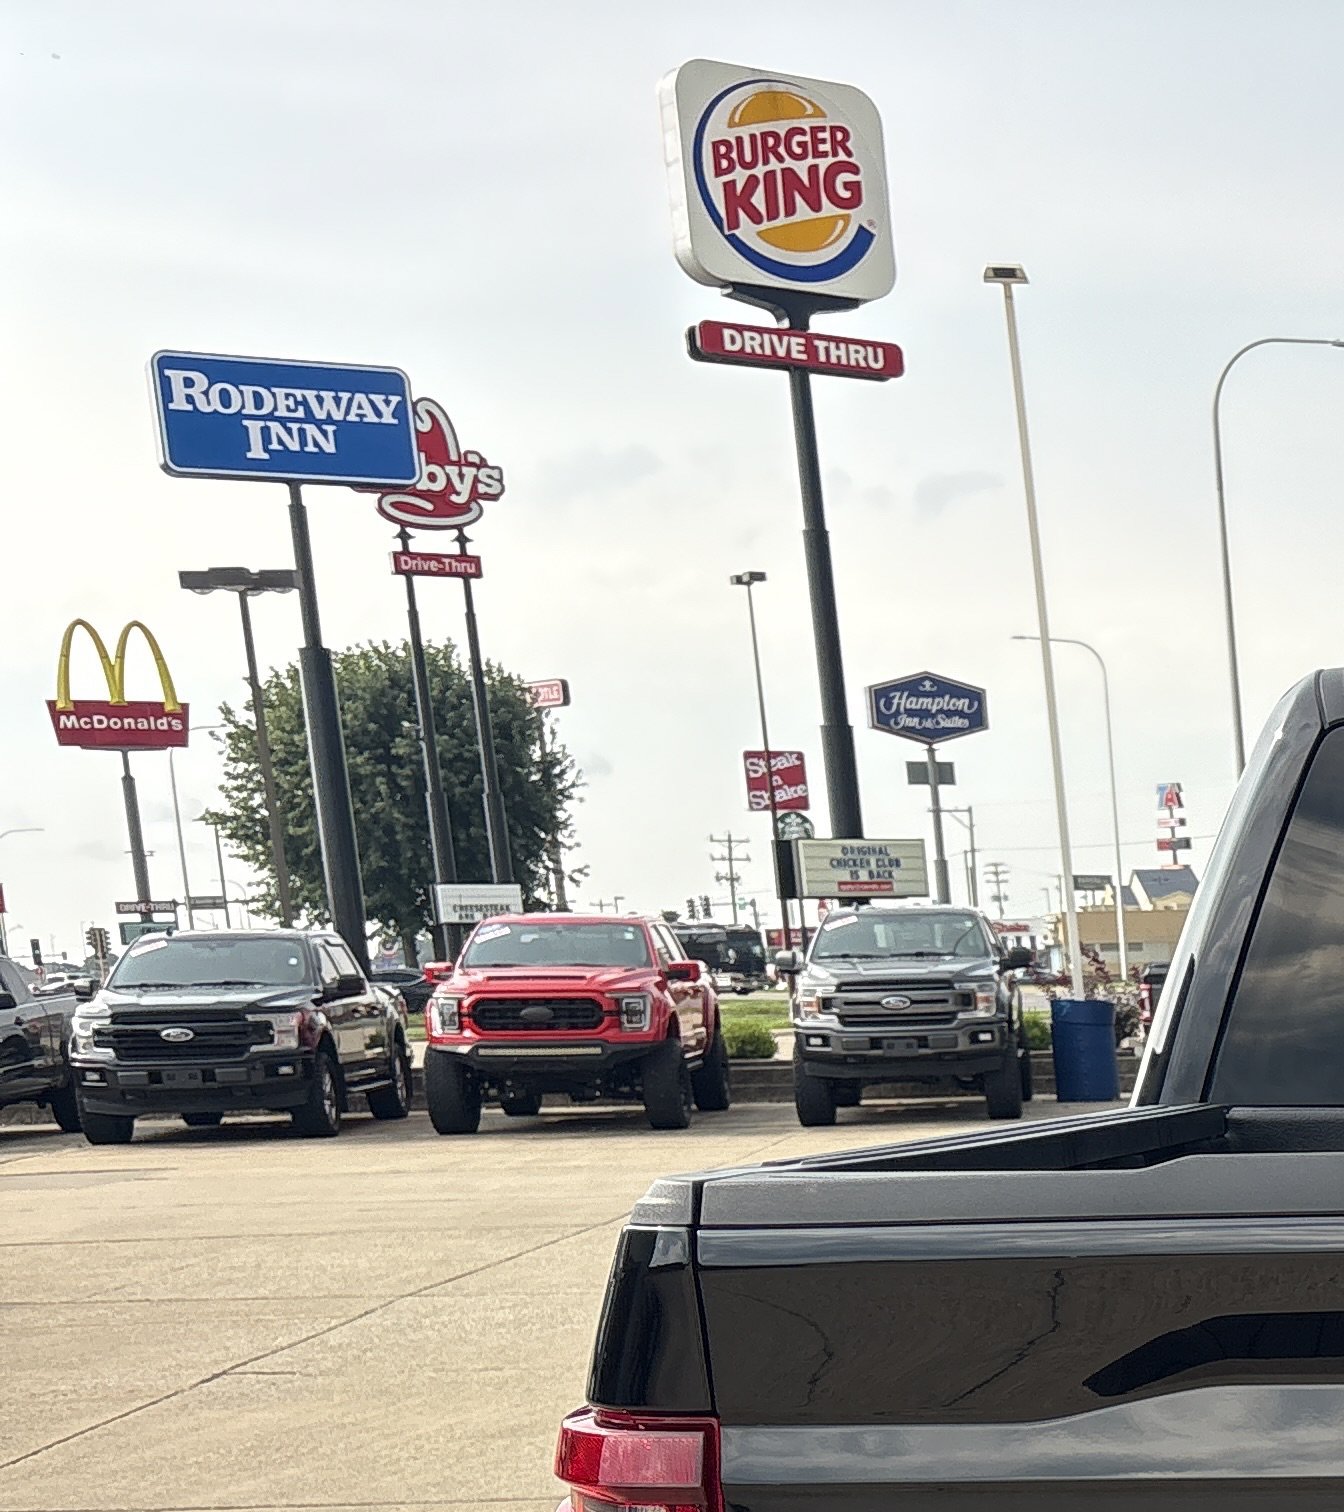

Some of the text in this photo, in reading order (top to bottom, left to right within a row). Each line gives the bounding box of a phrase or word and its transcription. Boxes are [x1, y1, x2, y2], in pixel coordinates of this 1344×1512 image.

[711, 124, 853, 178] BURGER
[722, 161, 863, 233] KING
[722, 327, 885, 370] DRIVE THRU
[165, 369, 402, 425] RODEWAY
[243, 420, 338, 459] INN
[418, 450, 503, 501] by's
[399, 556, 476, 575] Drive-Thru
[58, 714, 183, 732] McDonald's
[879, 691, 979, 714] Hampton
